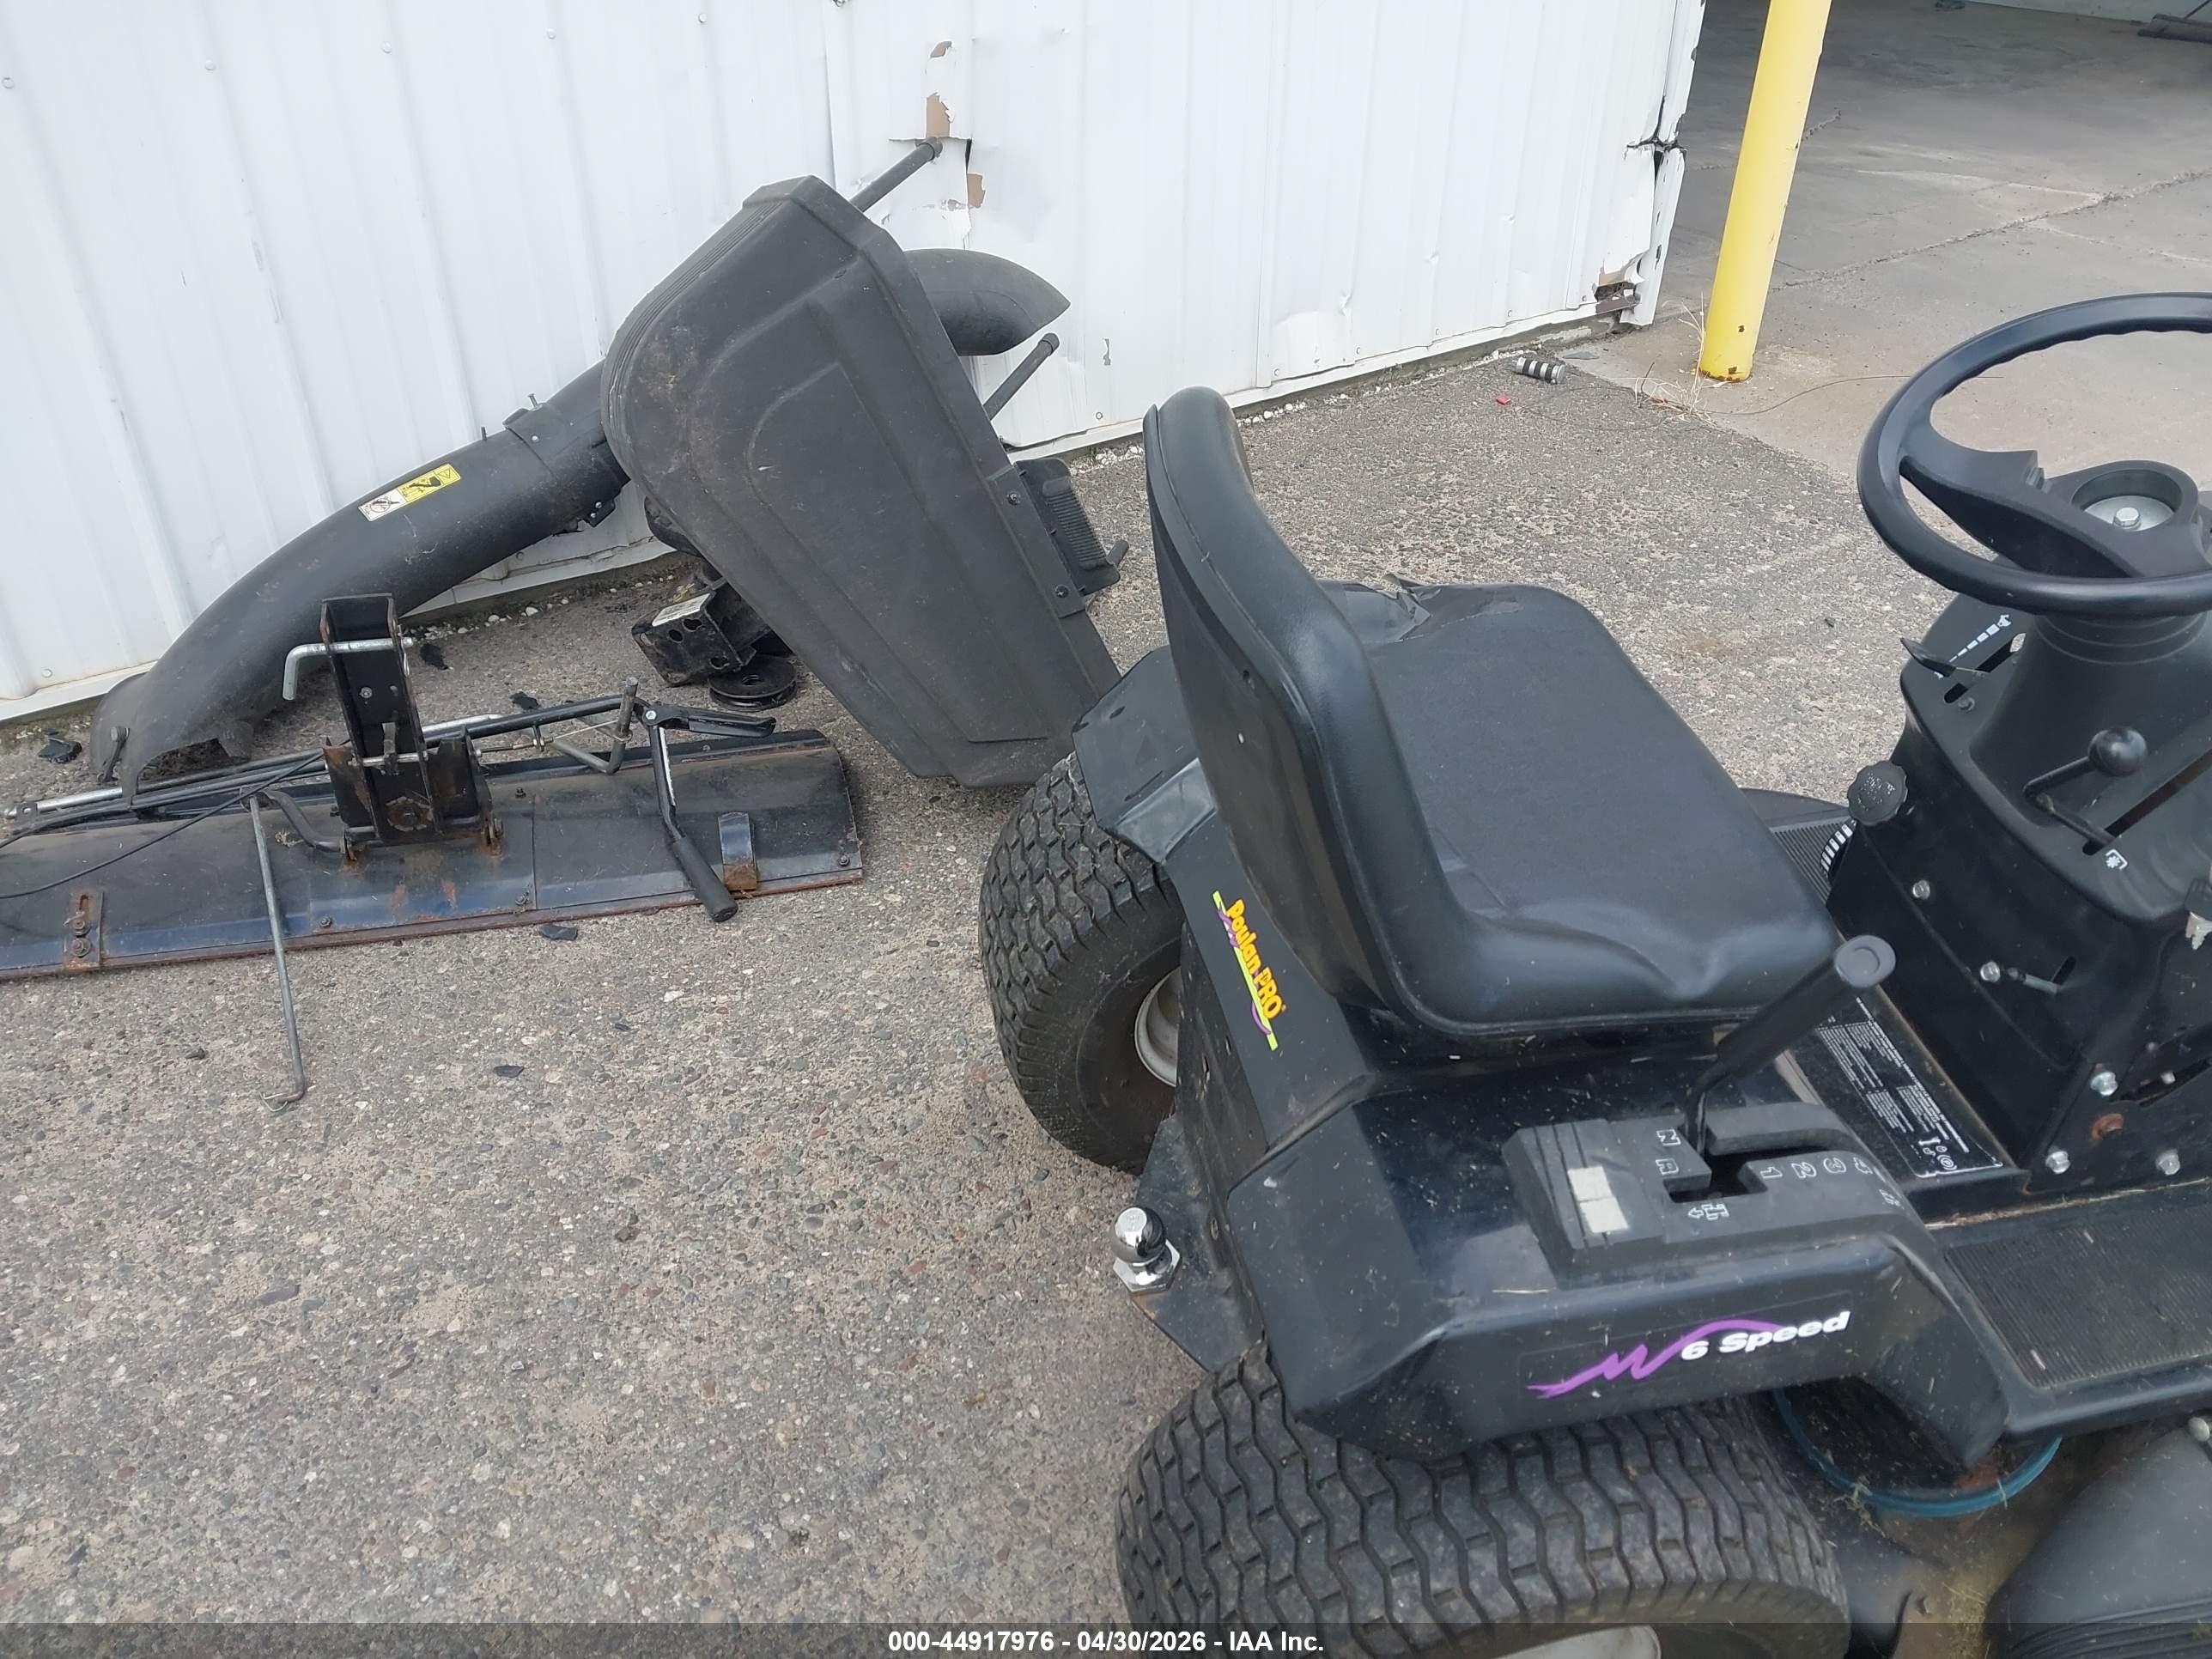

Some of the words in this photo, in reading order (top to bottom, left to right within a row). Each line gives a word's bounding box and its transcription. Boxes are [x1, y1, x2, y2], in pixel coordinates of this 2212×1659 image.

[1225, 898, 1261, 977] Poulan
[1656, 1158, 1680, 1176] R
[1759, 1165, 1784, 1179] 1
[1790, 1161, 1818, 1179] 2
[1823, 1157, 1848, 1174] 3
[1680, 1339, 1709, 1361] 6
[1718, 1310, 1851, 1353] Speed
